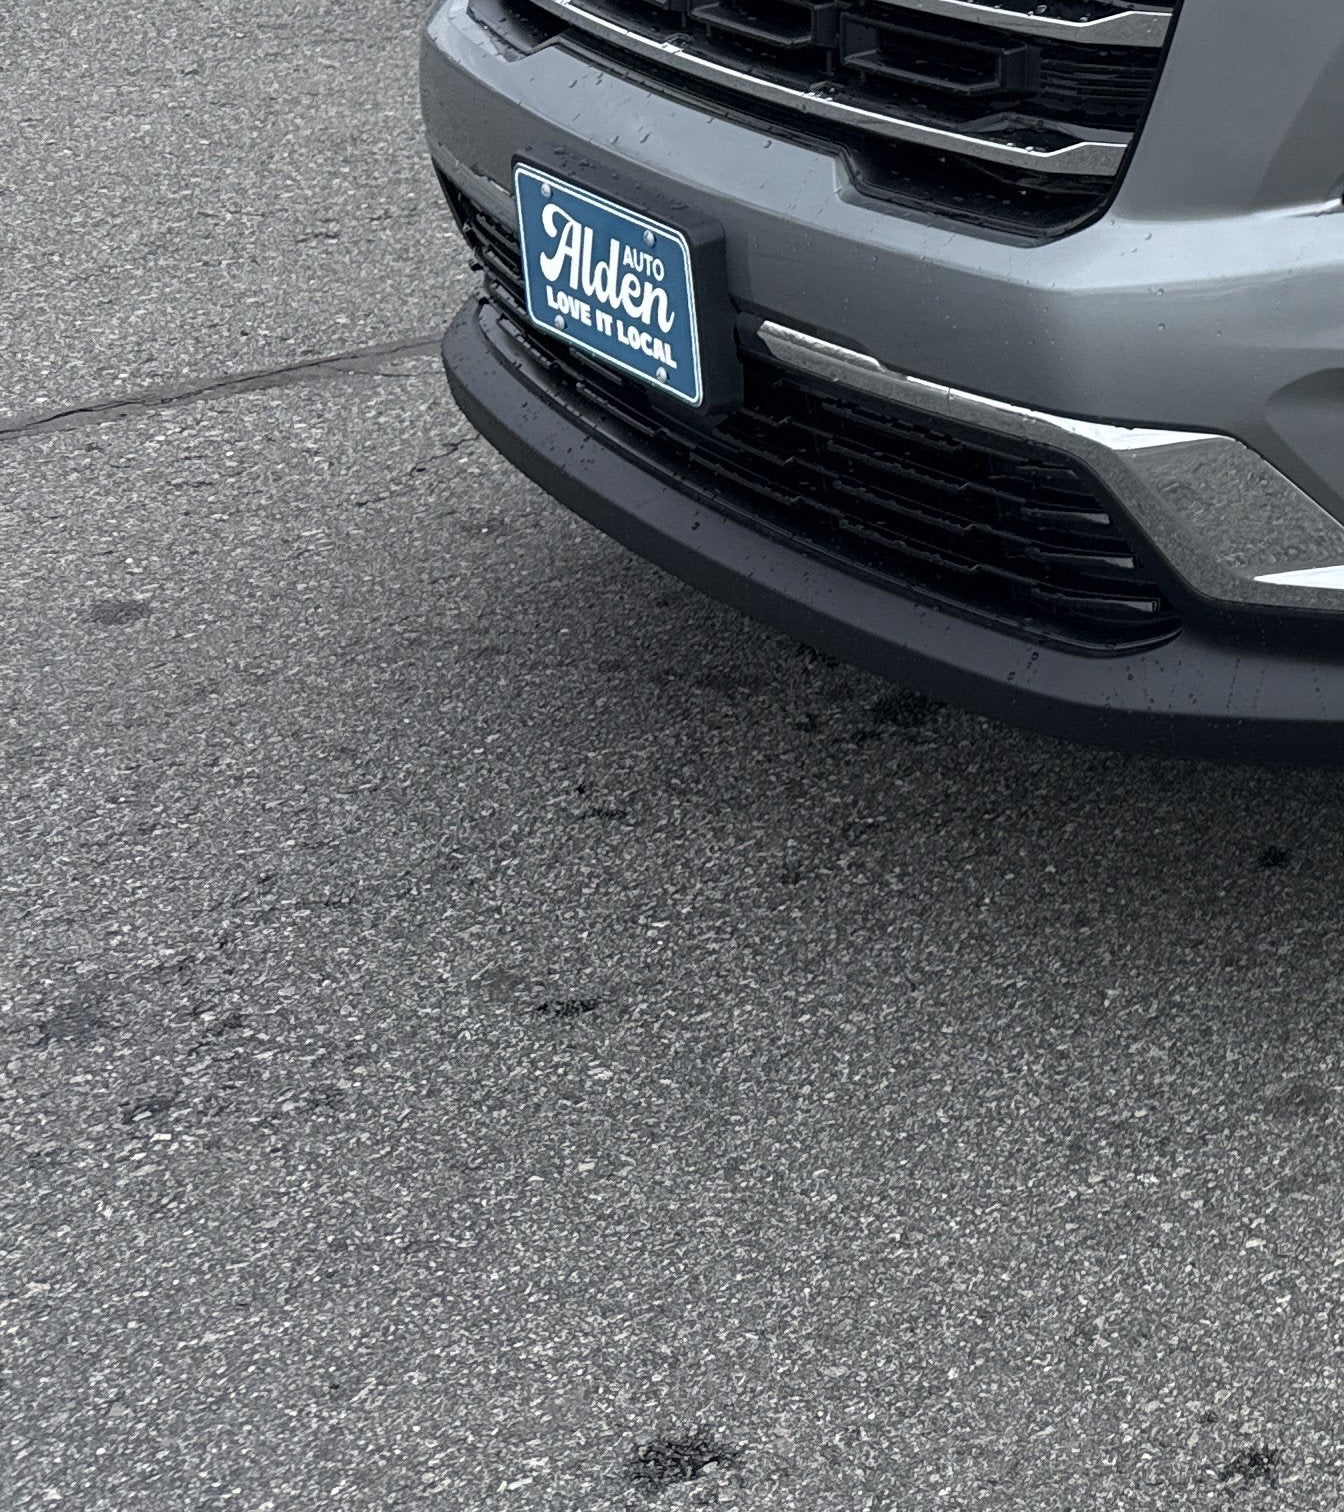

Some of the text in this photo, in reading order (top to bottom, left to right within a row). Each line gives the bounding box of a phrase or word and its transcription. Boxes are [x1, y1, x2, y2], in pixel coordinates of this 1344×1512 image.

[539, 202, 675, 334] Alden
[622, 245, 665, 282] AUTO
[546, 285, 678, 369] LOVE IT LOCAL
